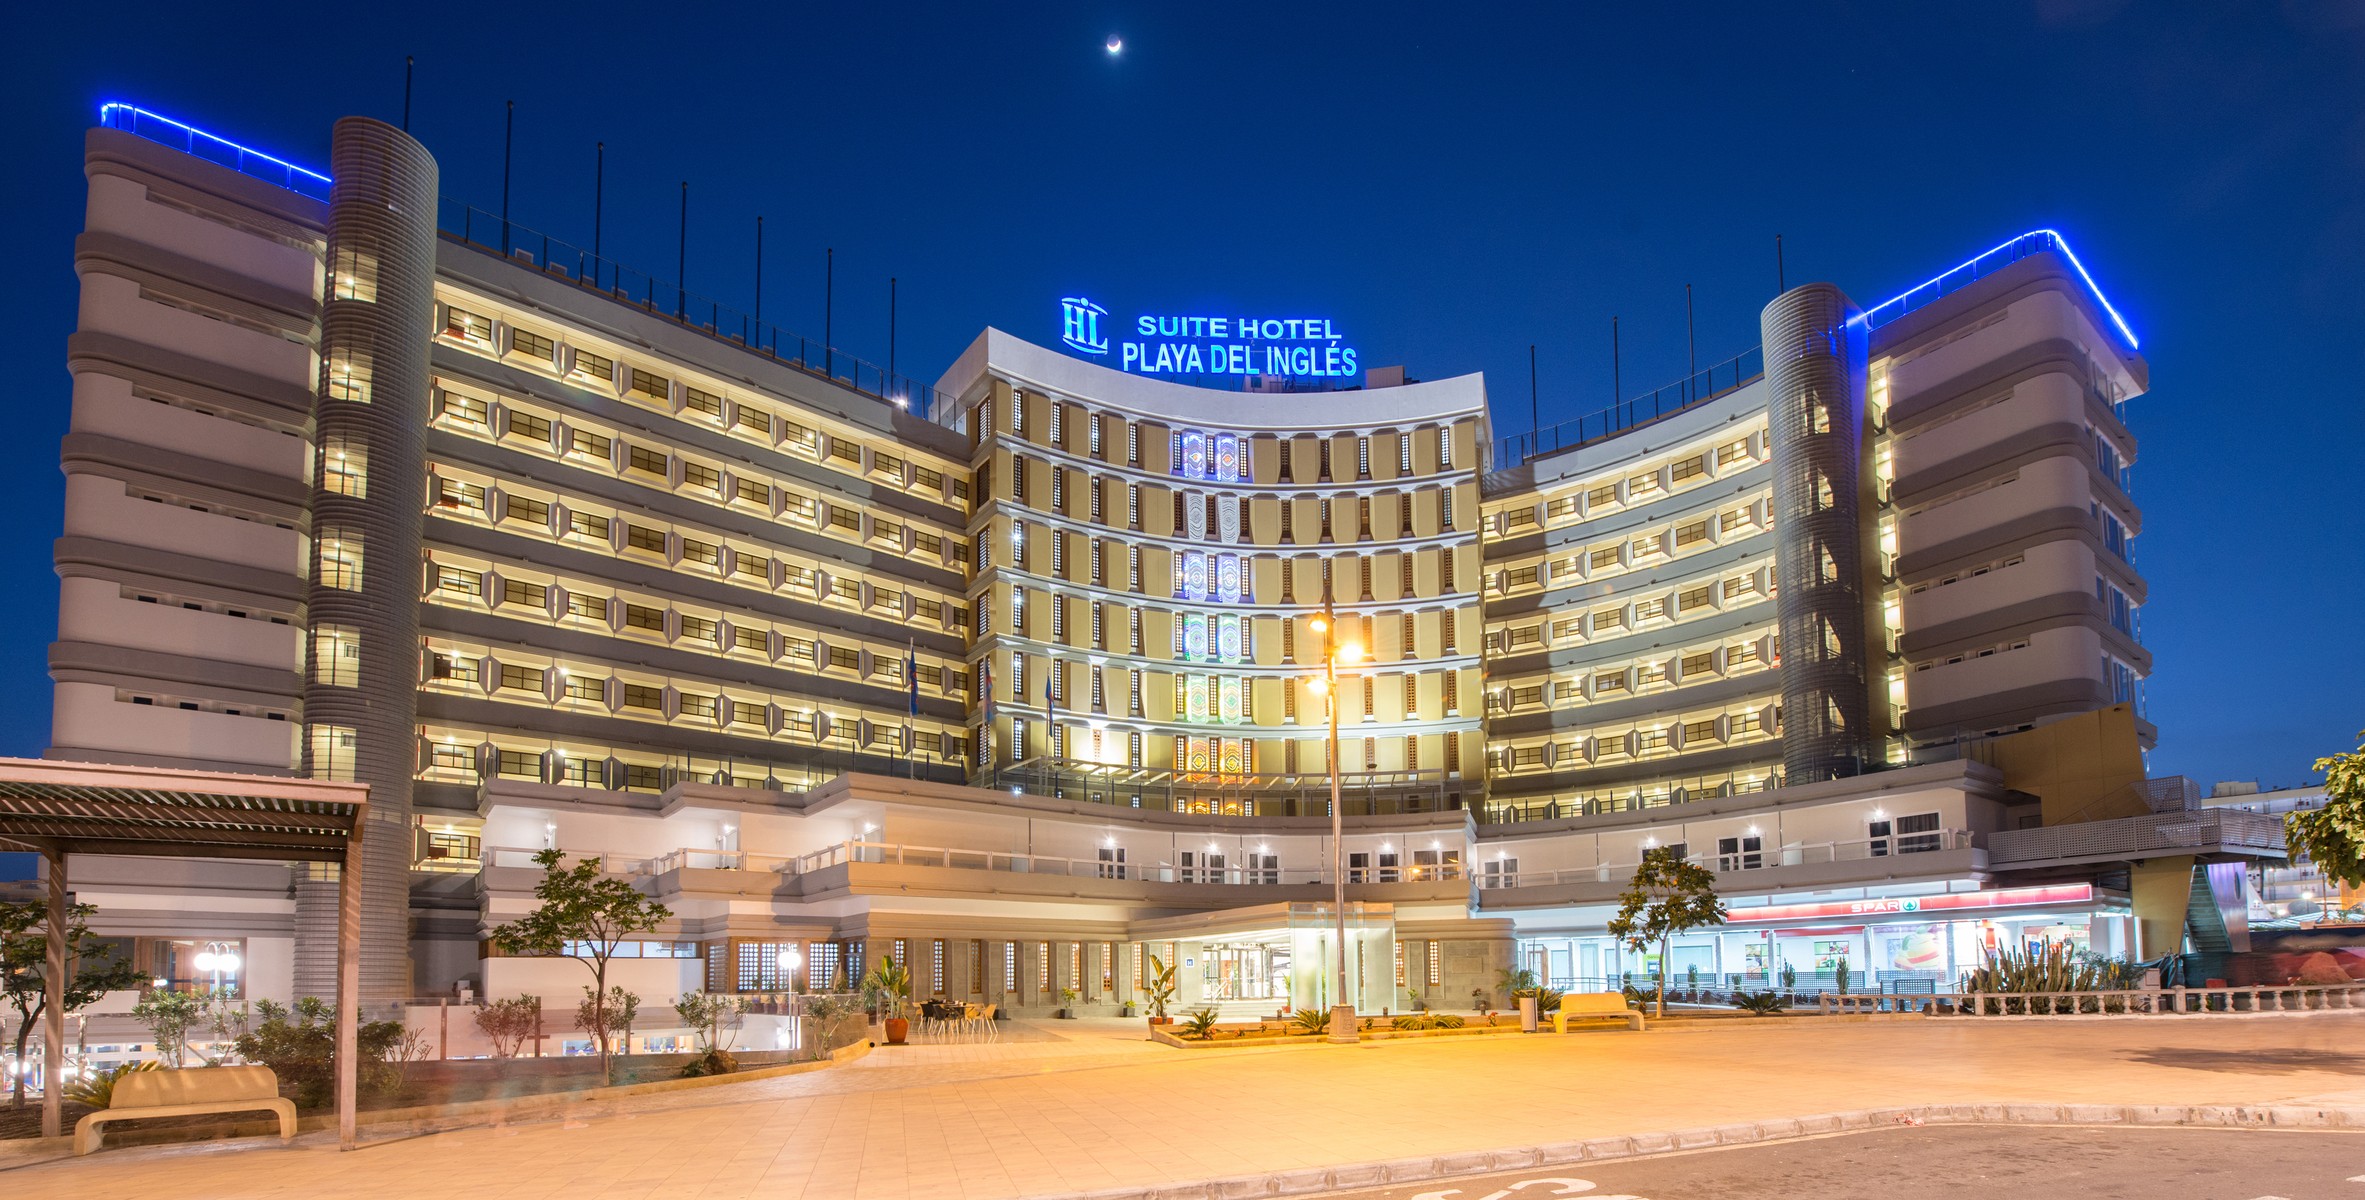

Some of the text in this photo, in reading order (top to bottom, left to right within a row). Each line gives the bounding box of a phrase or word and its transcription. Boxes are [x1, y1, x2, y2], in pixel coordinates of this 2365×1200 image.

[1138, 316, 1342, 339] SUITE HOTEL
[1123, 340, 1357, 376] PLAYA DEL INGLÉS
[1851, 901, 1899, 913] SPAR
